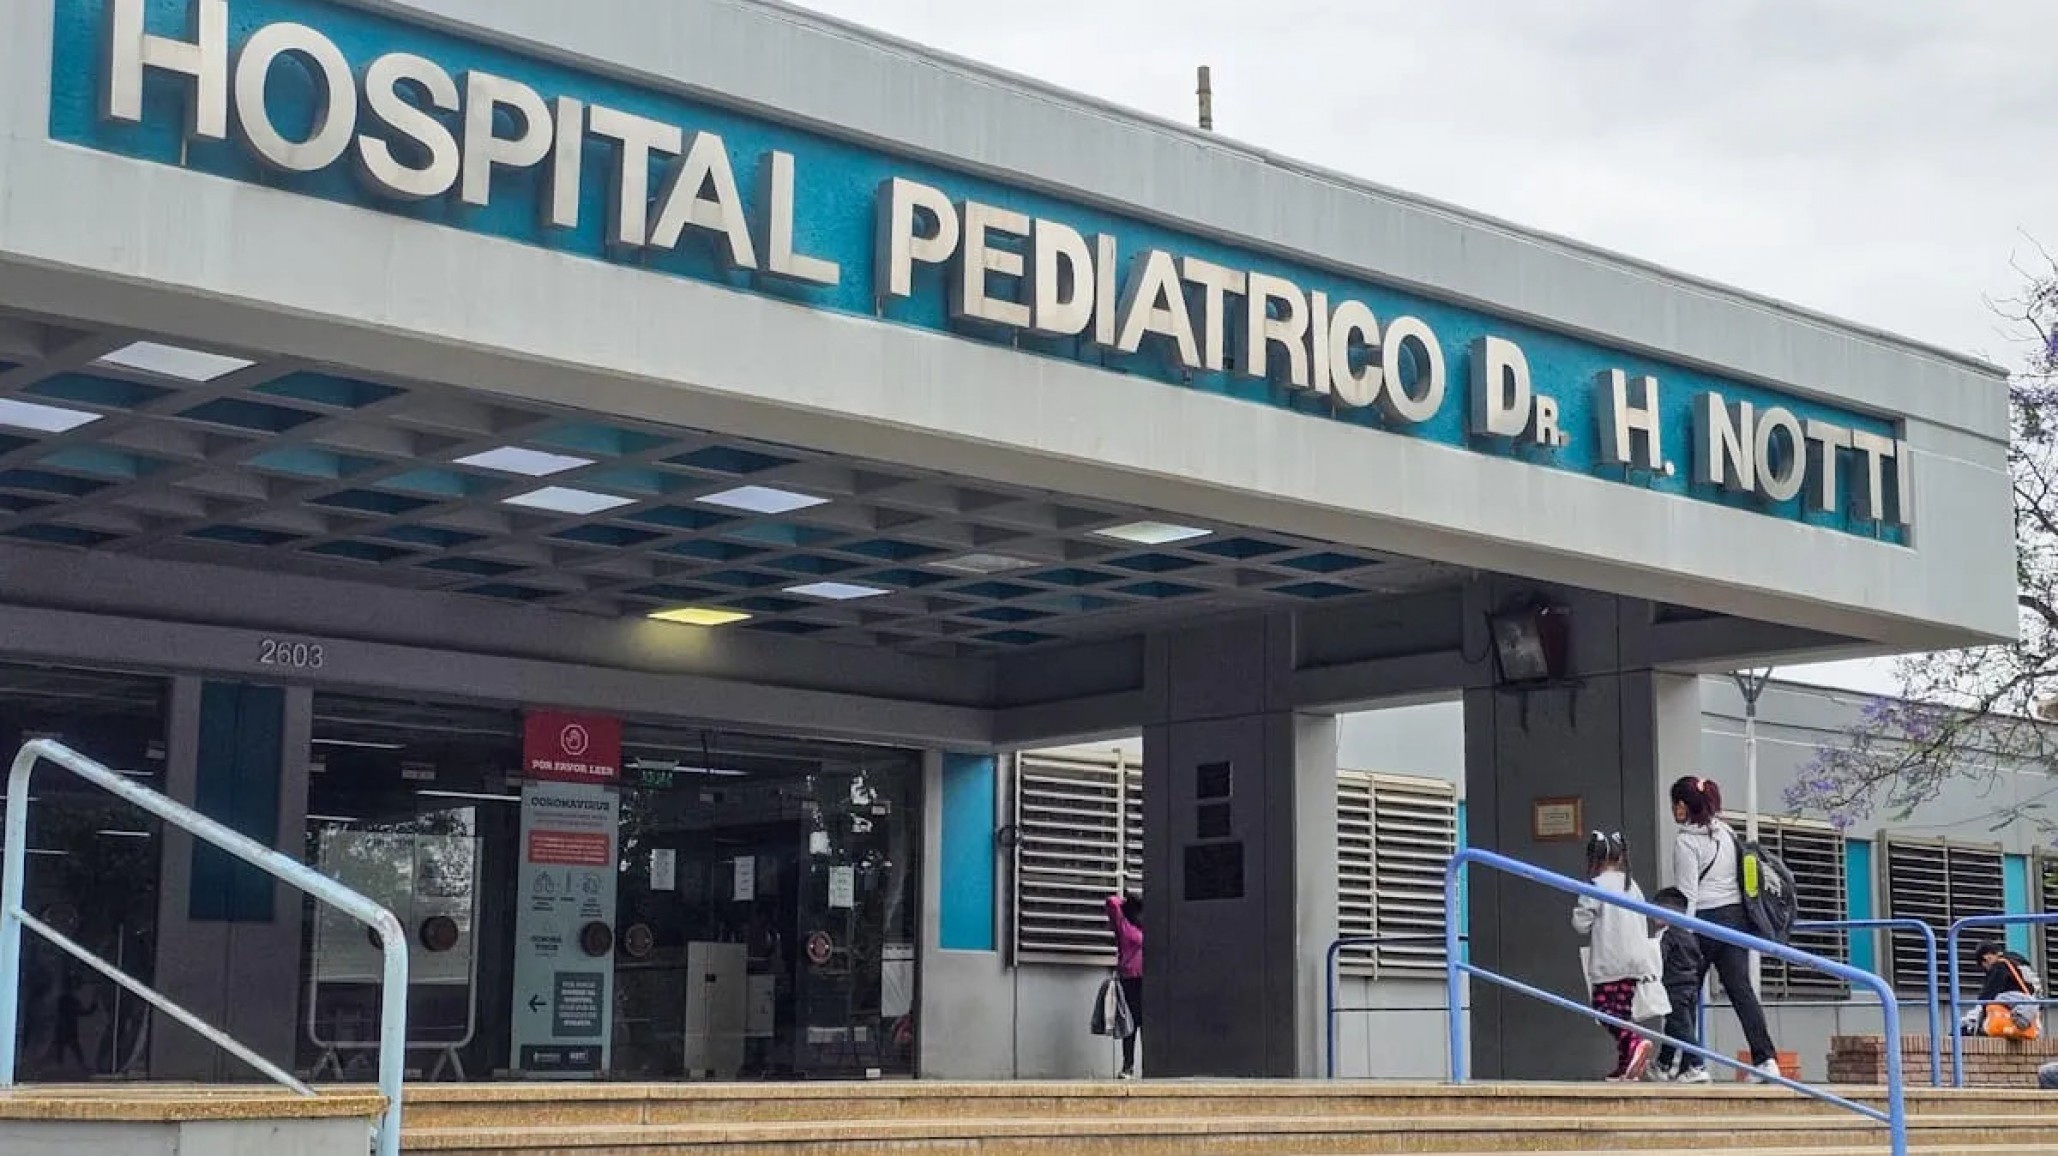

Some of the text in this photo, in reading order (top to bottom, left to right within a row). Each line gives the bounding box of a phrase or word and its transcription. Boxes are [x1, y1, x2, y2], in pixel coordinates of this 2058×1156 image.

[110, 0, 840, 285] HOSPITAL
[889, 176, 1446, 424] PEDIATRICO
[1611, 368, 1676, 476] H.
[1707, 390, 1912, 526] NOTTI
[260, 638, 324, 669] 2603
[531, 797, 610, 811] CORONAVIRUS
